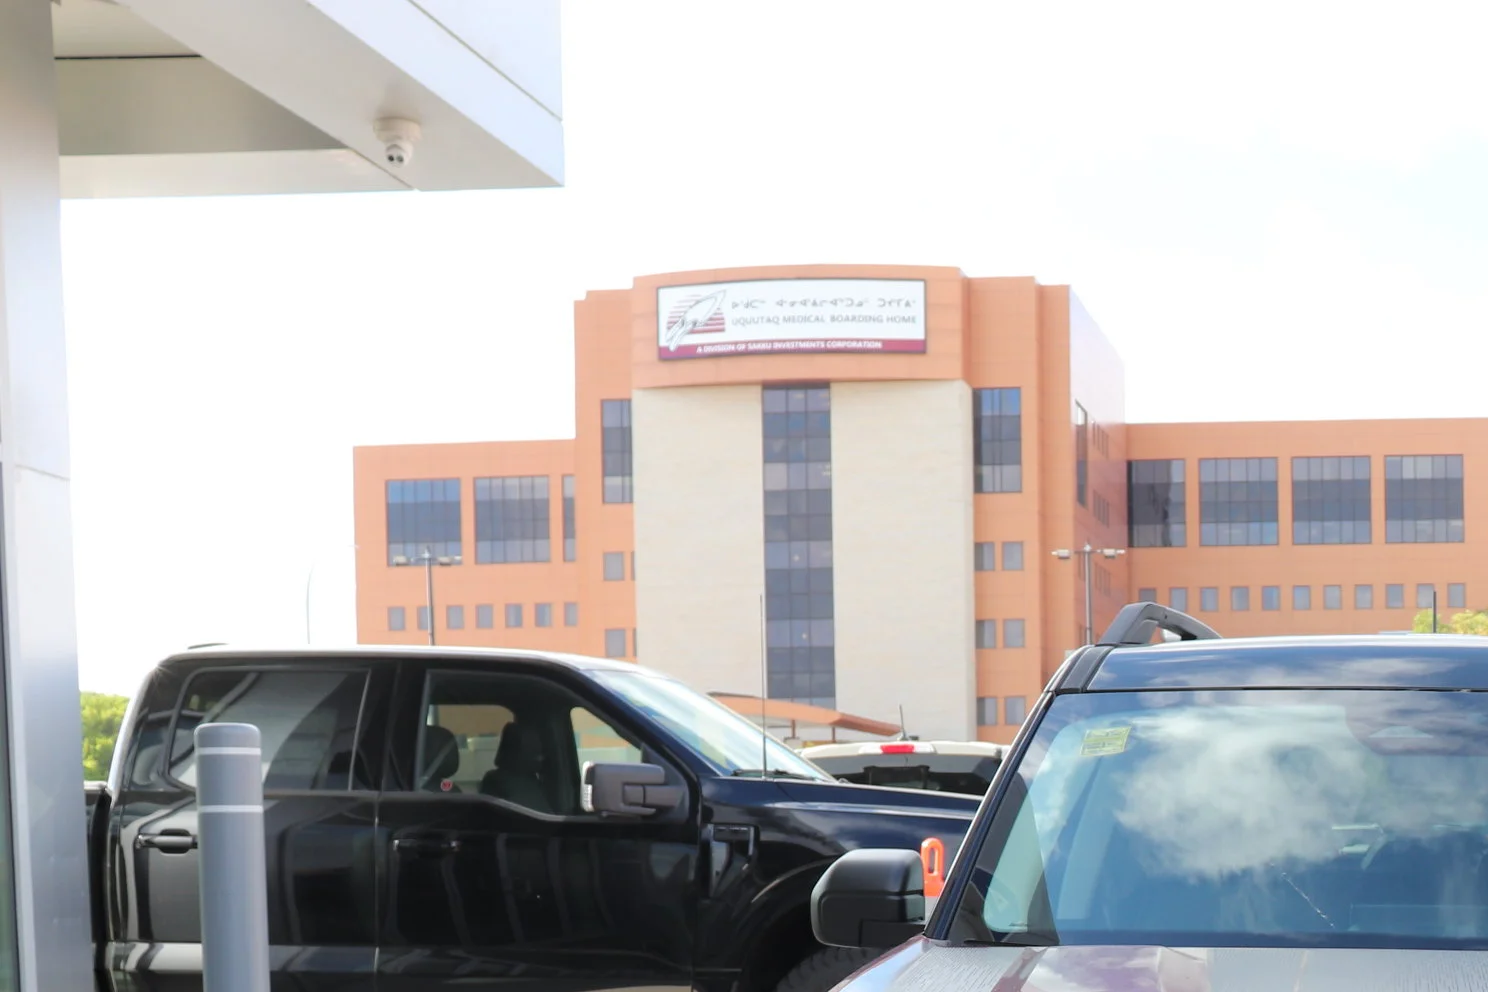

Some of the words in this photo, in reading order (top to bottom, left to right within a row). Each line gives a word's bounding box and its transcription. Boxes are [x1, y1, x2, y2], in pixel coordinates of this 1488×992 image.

[731, 316, 780, 326] UQUUTAQ
[782, 314, 825, 324] MEDICAL
[829, 314, 884, 323] BOARDING
[886, 315, 917, 323] HOME
